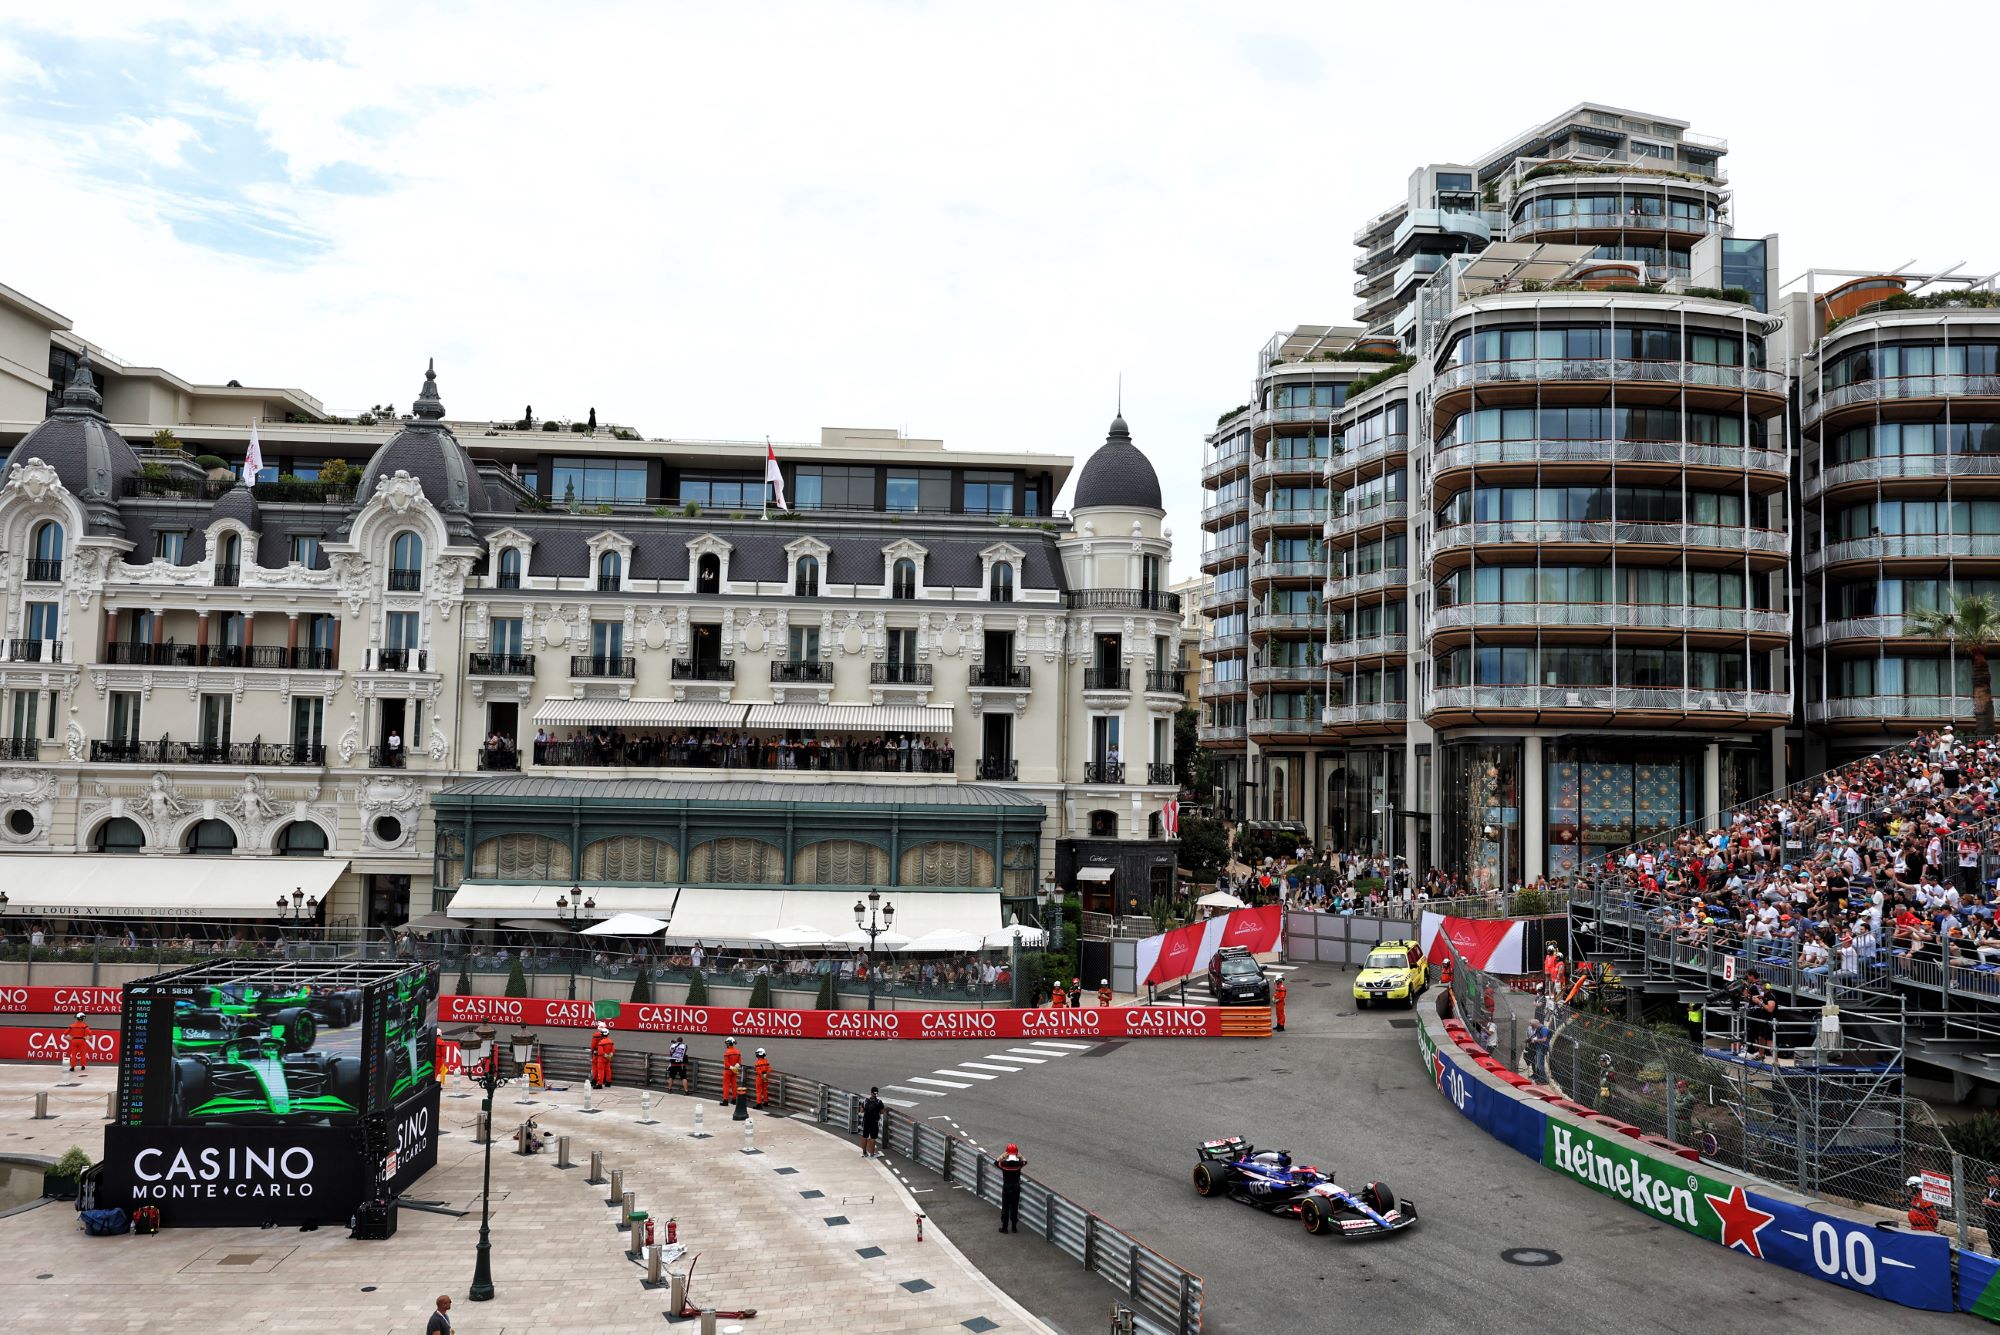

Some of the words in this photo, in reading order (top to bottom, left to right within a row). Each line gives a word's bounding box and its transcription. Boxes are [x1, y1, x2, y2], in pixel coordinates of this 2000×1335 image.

[86, 907, 101, 915] XV
[1726, 965, 1731, 979] B
[453, 998, 522, 1015] CASINO
[638, 1006, 708, 1024] CASINO
[732, 1011, 802, 1028] CASINO
[827, 1013, 899, 1029] CASINO
[921, 1013, 996, 1029] CASINO
[1022, 1010, 1099, 1028] CASINO
[1126, 1010, 1206, 1027] CASINO
[29, 1032, 114, 1052] CASNO
[525, 1066, 541, 1087] FCY
[396, 1106, 428, 1154] SINO
[134, 1146, 314, 1181] CASINO
[1552, 1124, 1699, 1227] Heineken
[133, 1184, 217, 1198] MONTE
[235, 1183, 313, 1197] CARLO
[1248, 1181, 1272, 1195] VISA
[1812, 1221, 1876, 1286] 0.0
